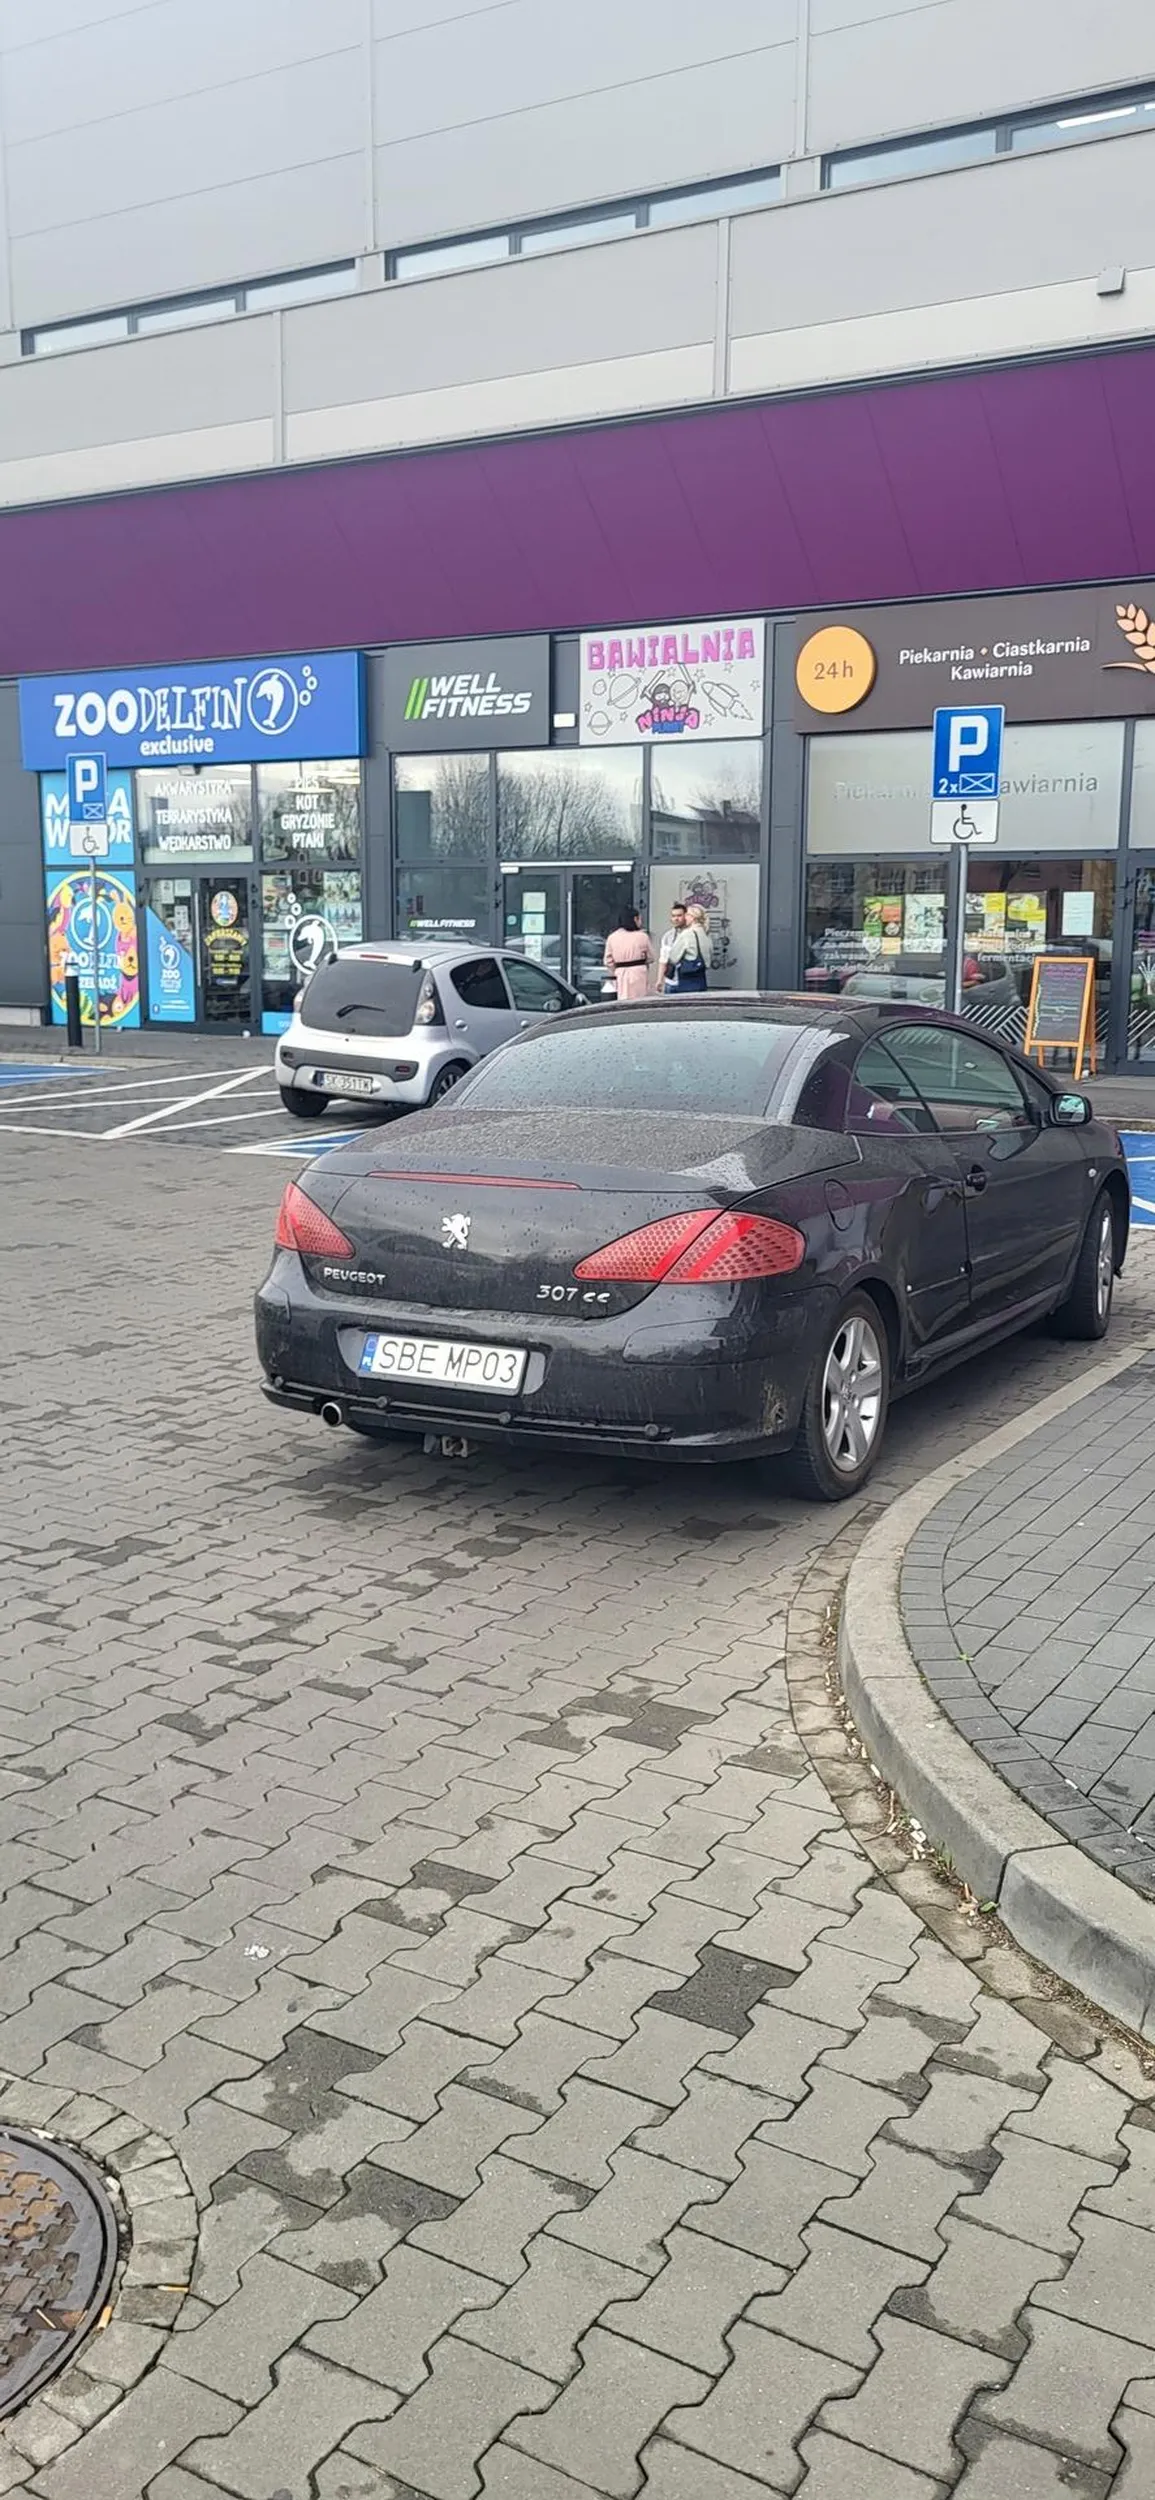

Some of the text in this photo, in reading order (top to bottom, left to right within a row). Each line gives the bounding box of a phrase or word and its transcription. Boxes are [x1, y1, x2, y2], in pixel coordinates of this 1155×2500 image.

[587, 627, 755, 671] BAWIALNIA
[899, 636, 1091, 666] Piekarnia Ciastkarnia
[950, 661, 1033, 681] Kawiarnia
[430, 672, 501, 697] WELL
[421, 692, 533, 720] FITNESS
[634, 704, 700, 734] NINJA
[140, 733, 214, 756] exclusive
[948, 714, 989, 772] P
[75, 759, 98, 803] P
[938, 778, 958, 795] 2x
[1000, 773, 1099, 795] awiarnia
[296, 794, 319, 811] KOT
[155, 807, 233, 825] TERRARYSTYKA
[281, 812, 336, 830] GRYZONIE
[158, 834, 232, 854] WĘDKARSTWO
[292, 831, 325, 849] PTAKI
[323, 1266, 386, 1286] PEUGEOT
[536, 1285, 579, 1301] 307
[378, 1340, 518, 1383] SBE MP03
